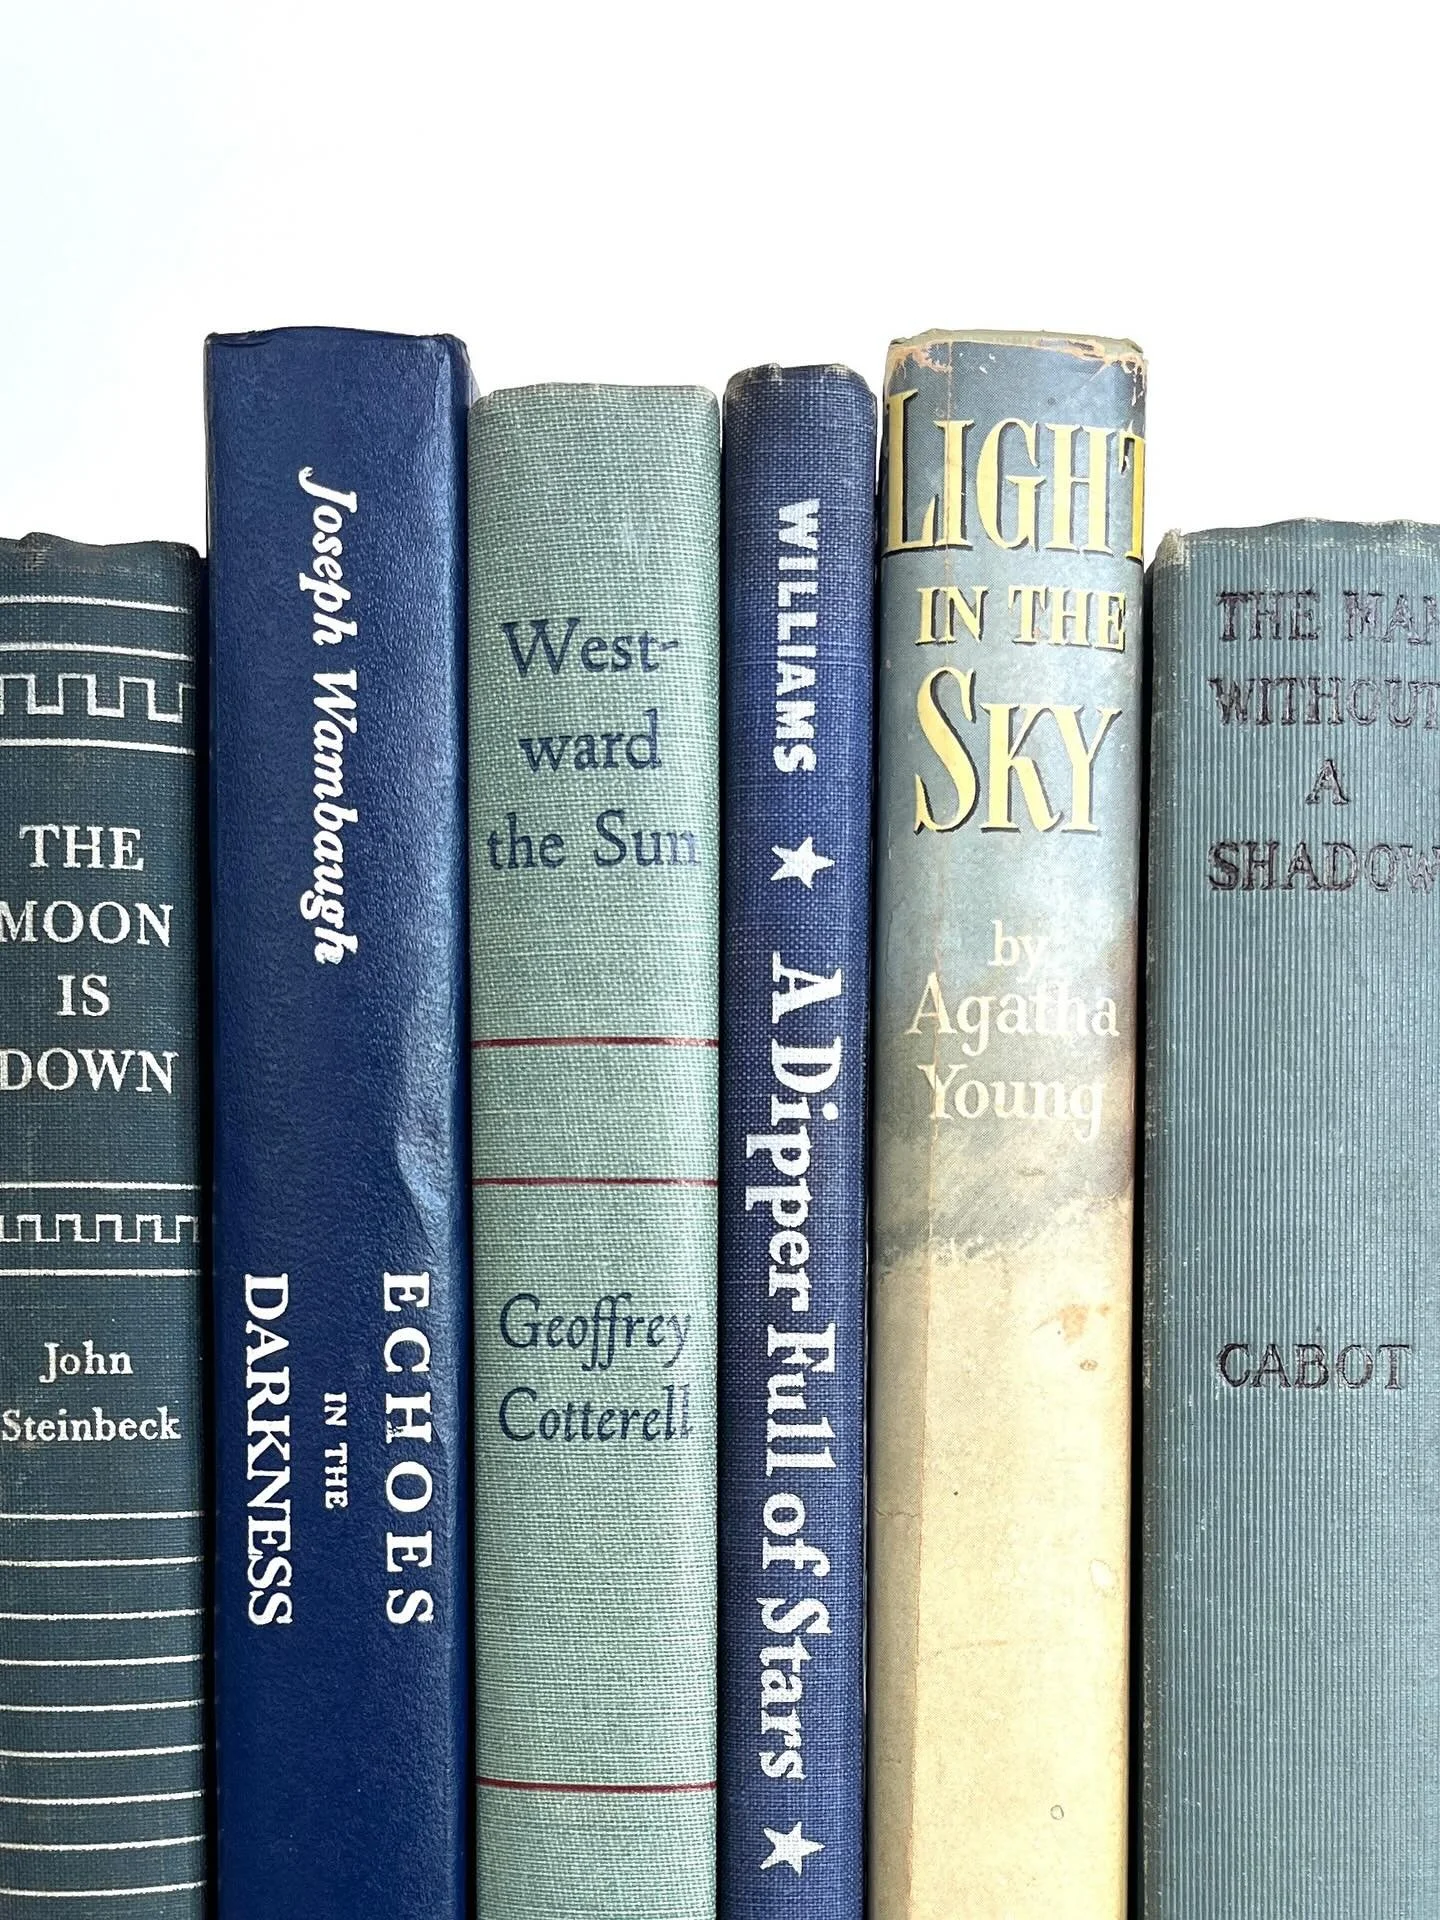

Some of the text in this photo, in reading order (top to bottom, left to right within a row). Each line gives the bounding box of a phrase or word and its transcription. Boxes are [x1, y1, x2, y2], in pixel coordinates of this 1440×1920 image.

[883, 389, 1145, 565] LIGHT
[773, 498, 820, 774] WILLIAMS
[916, 584, 1127, 653] IN THE
[1217, 590, 1319, 642] THE
[299, 466, 358, 965] Joseph Wambaugh
[1208, 676, 1440, 729] WITHOUT
[519, 708, 662, 772] ward
[915, 666, 1122, 835] SKY
[1305, 758, 1350, 805] A
[20, 824, 145, 871] THE
[487, 810, 701, 869] the Sun
[1208, 841, 1440, 892] SHADOW
[0, 900, 174, 947] MOON
[988, 920, 1048, 982] by
[57, 975, 110, 1017] IS
[904, 971, 1120, 1057] Agatha
[0, 1047, 179, 1094] DOWN
[917, 1062, 1106, 1142] Young
[39, 1342, 133, 1384] John
[500, 1292, 691, 1372] Geoffrey
[744, 951, 842, 1779] A Dipper Full of Stars
[1217, 1343, 1413, 1389] CABOT
[1, 1407, 182, 1443] Steinbeck
[499, 1384, 693, 1442] Cotterell
[245, 1273, 293, 1626] DARKNESS
[323, 1392, 348, 1509] IN THE
[383, 1272, 434, 1625] ECHOES
